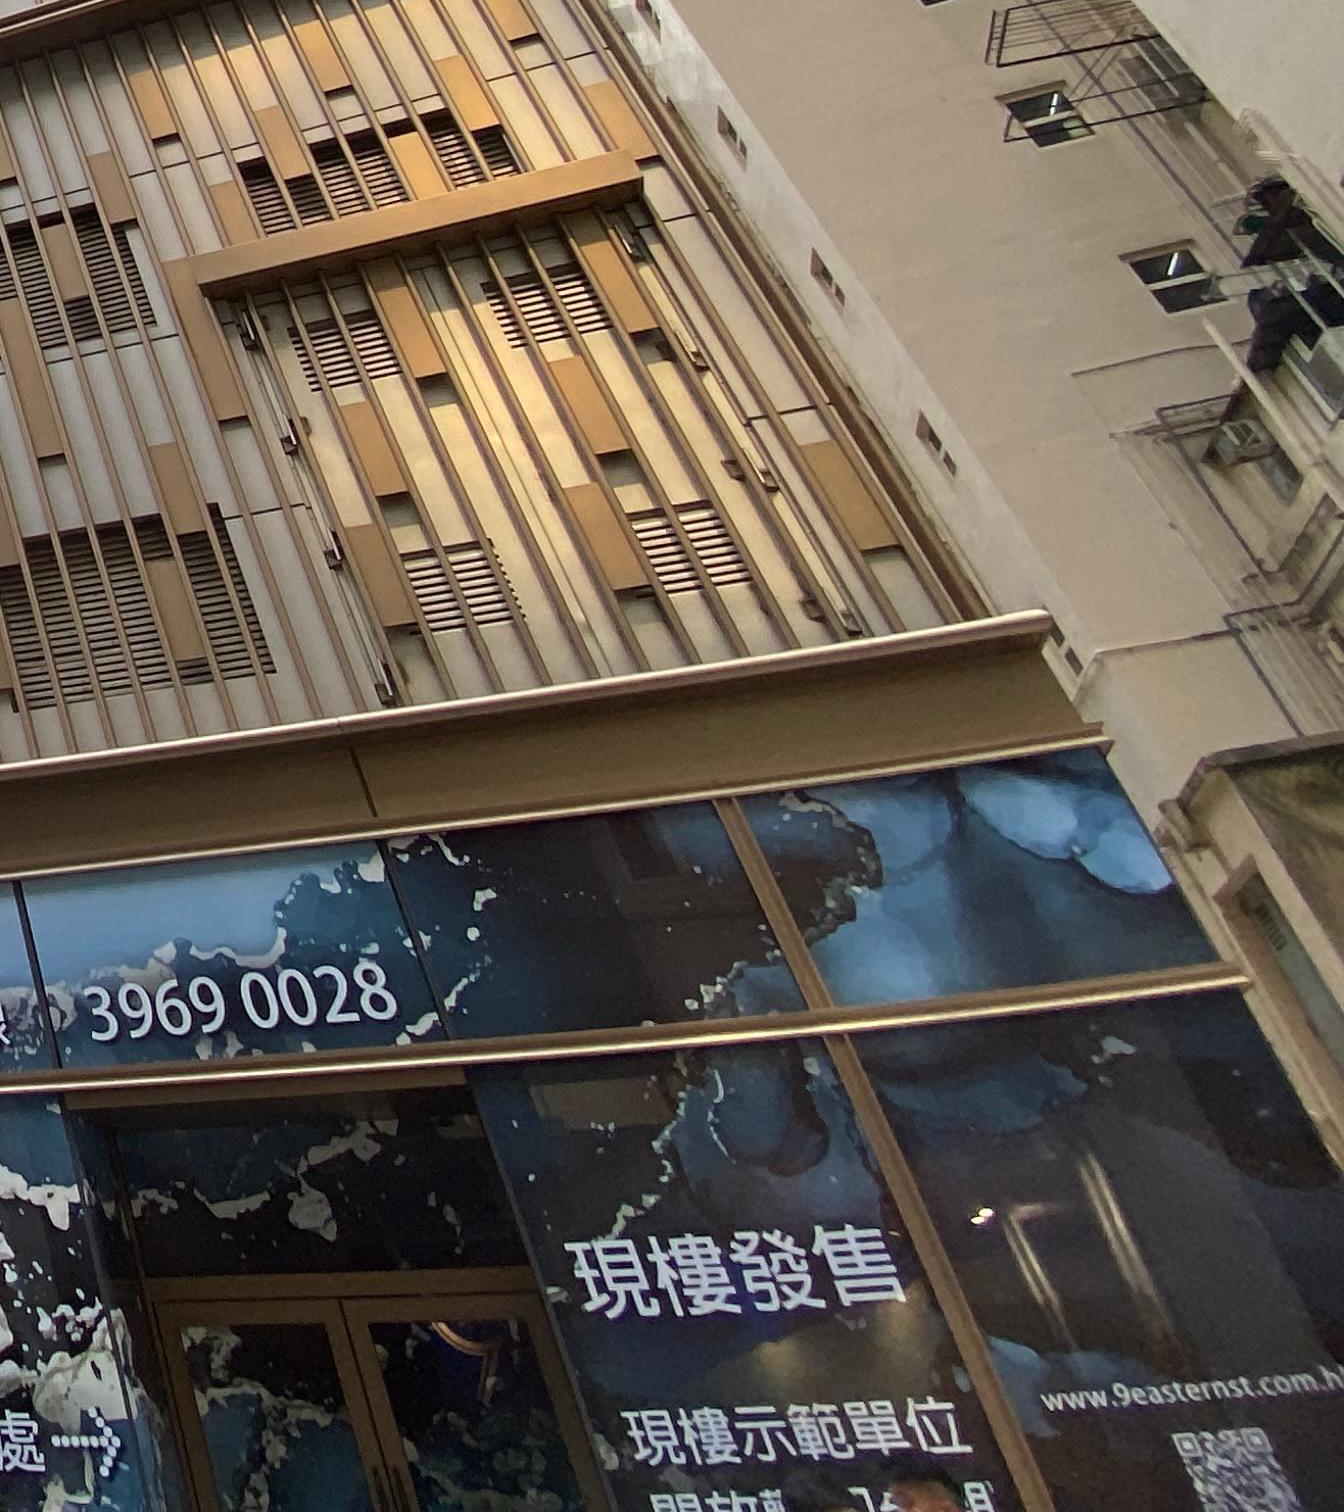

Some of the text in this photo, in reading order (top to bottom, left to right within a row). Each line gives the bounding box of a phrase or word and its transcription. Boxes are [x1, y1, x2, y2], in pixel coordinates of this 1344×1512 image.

[84, 961, 398, 1042] 3969 0028
[564, 1223, 908, 1319] 現樓發售
[1040, 1363, 1344, 1412] www.9easternst.com.h
[620, 1396, 974, 1466] 現樓示範單位
